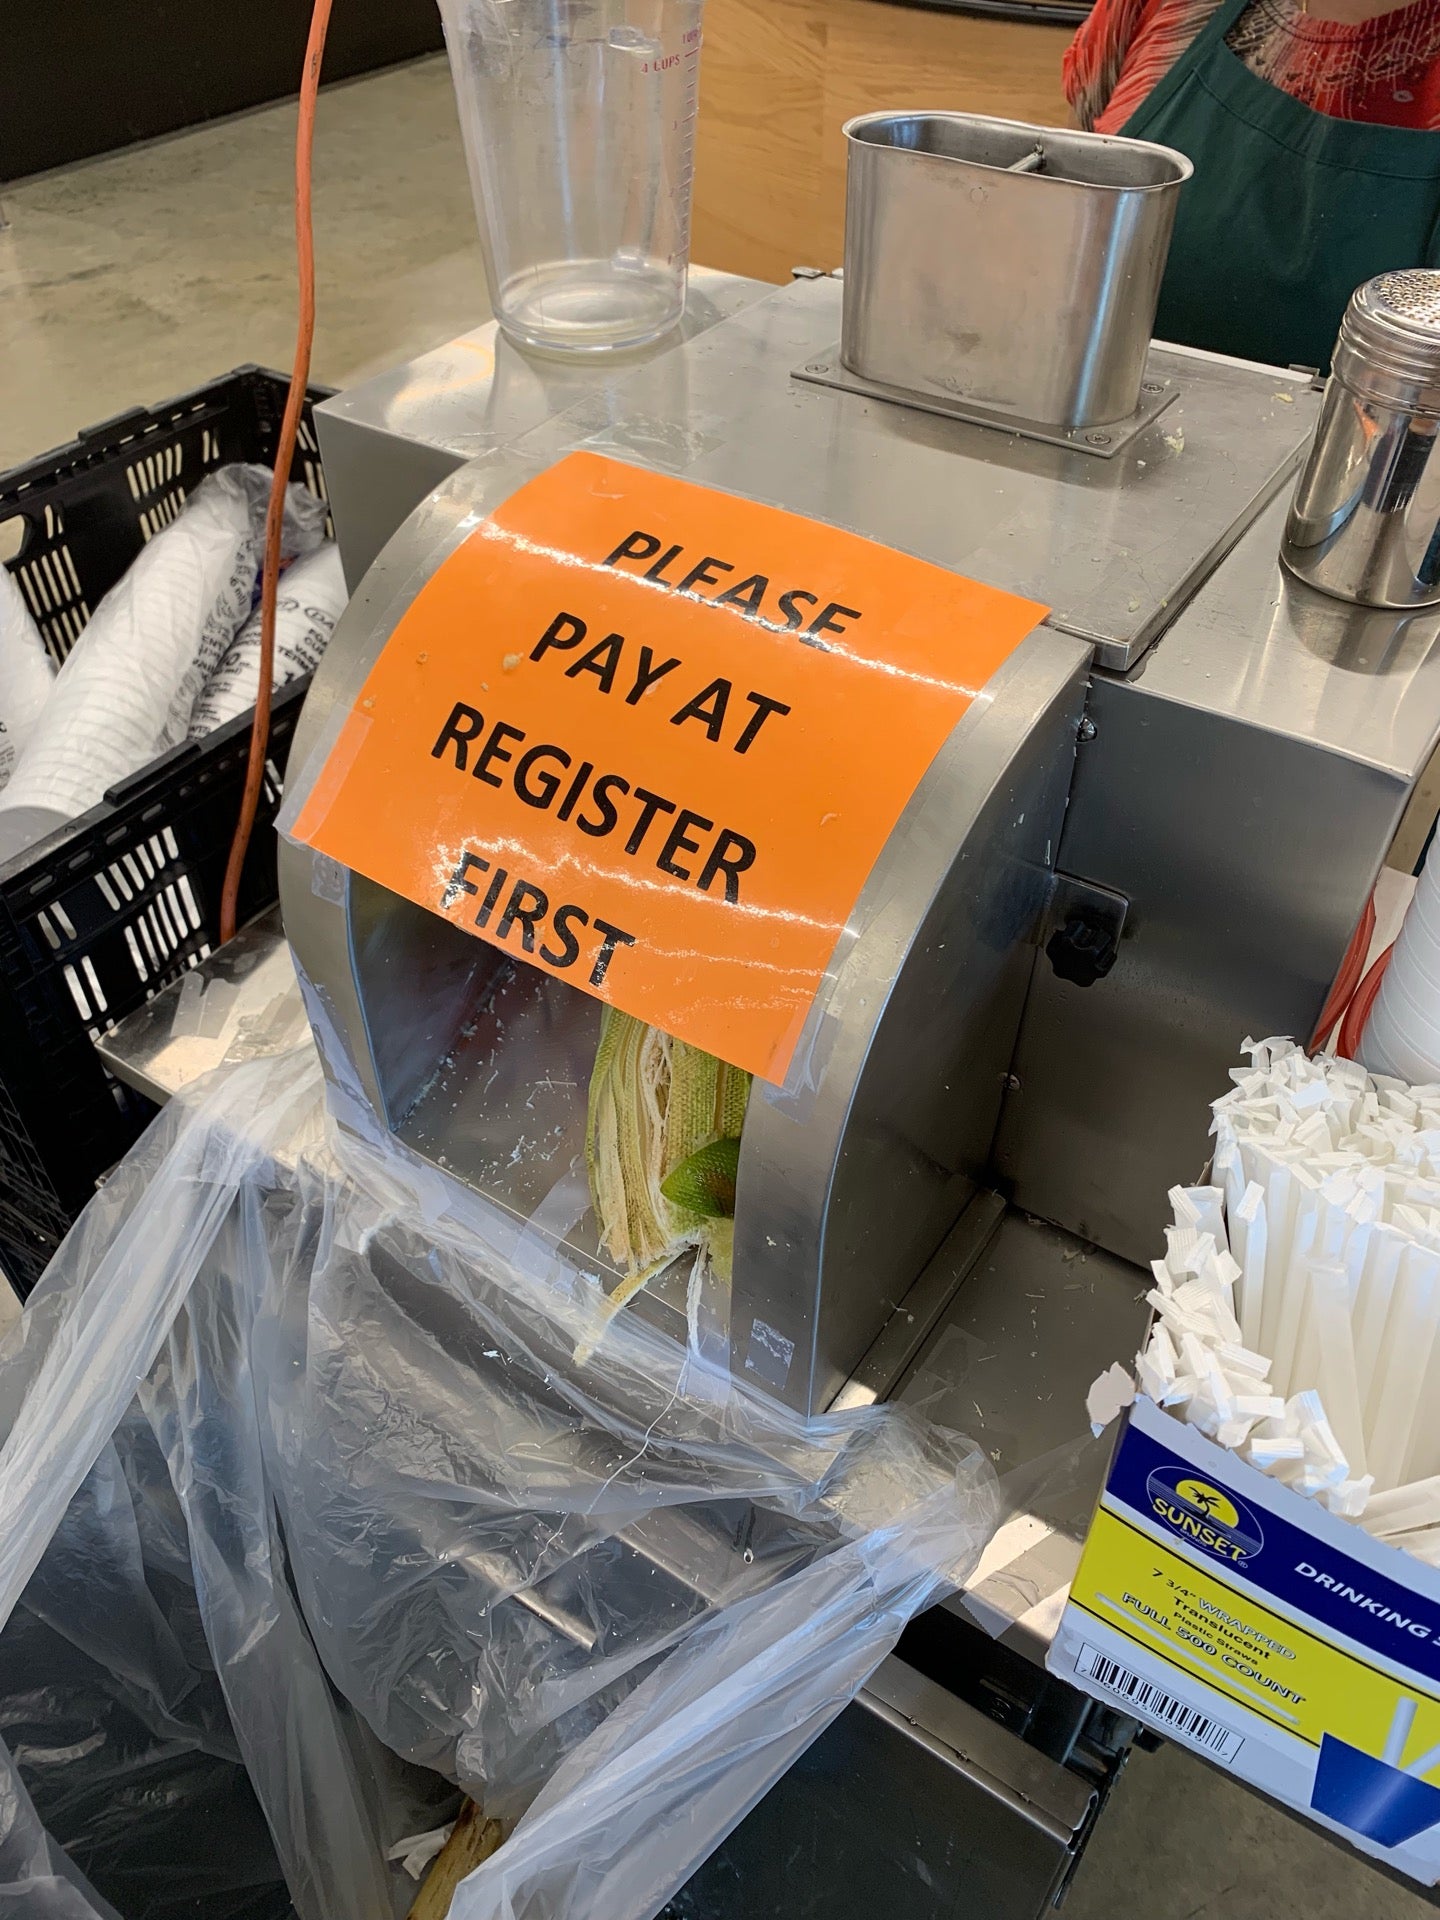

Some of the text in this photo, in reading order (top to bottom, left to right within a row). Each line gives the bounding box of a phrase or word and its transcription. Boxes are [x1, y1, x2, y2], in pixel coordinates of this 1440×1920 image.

[653, 54, 680, 72] CUPS
[603, 530, 862, 652] PLEASE
[529, 612, 791, 754] PAY AT
[431, 702, 757, 902] REGISTER
[440, 852, 637, 988] FIRST
[1152, 1497, 1247, 1562] SUNSET
[1152, 1568, 1297, 1660] 7 3/4" WRAPPED
[1173, 1596, 1271, 1660] Translucent
[1173, 1611, 1259, 1666] Plastic Straws
[1293, 1562, 1433, 1638] DRINKING
[1121, 1591, 1307, 1706] FULL 500 COUNT
